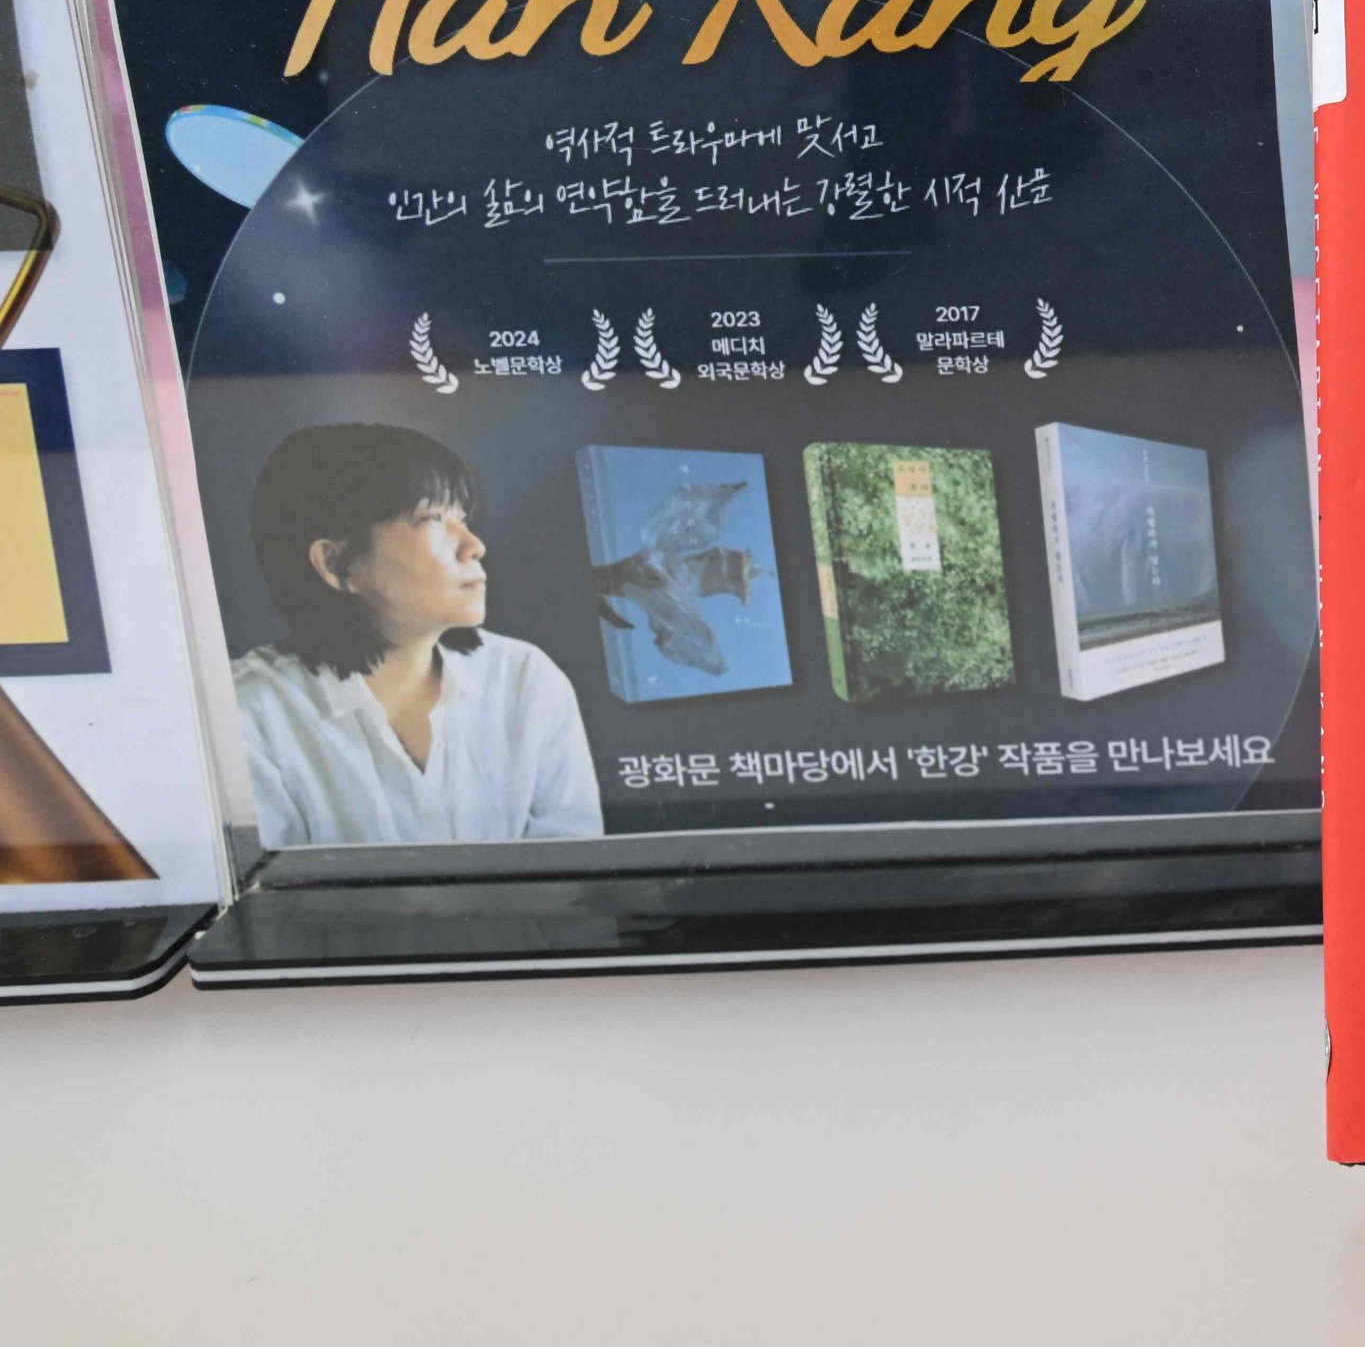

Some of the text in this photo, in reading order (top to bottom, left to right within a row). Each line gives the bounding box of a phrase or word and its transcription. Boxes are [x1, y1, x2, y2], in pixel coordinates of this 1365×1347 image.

[545, 113, 885, 166] 역사적 트라우마에 맞서고
[388, 167, 1054, 228] 인간의 삶의 연약함을 드러내는 강렬한 시적 산문
[711, 311, 760, 327] 2023
[936, 306, 979, 322] 2017
[490, 331, 539, 347] 2024
[712, 337, 765, 355] 메디치
[917, 331, 1004, 350] 말라파르테
[475, 356, 561, 375] 노벨문학상
[698, 361, 784, 380] 외국문학상
[938, 356, 988, 374] 문학상
[619, 734, 1274, 787] 광화문 책마당에서 '한강' 작품을 만나보세요
